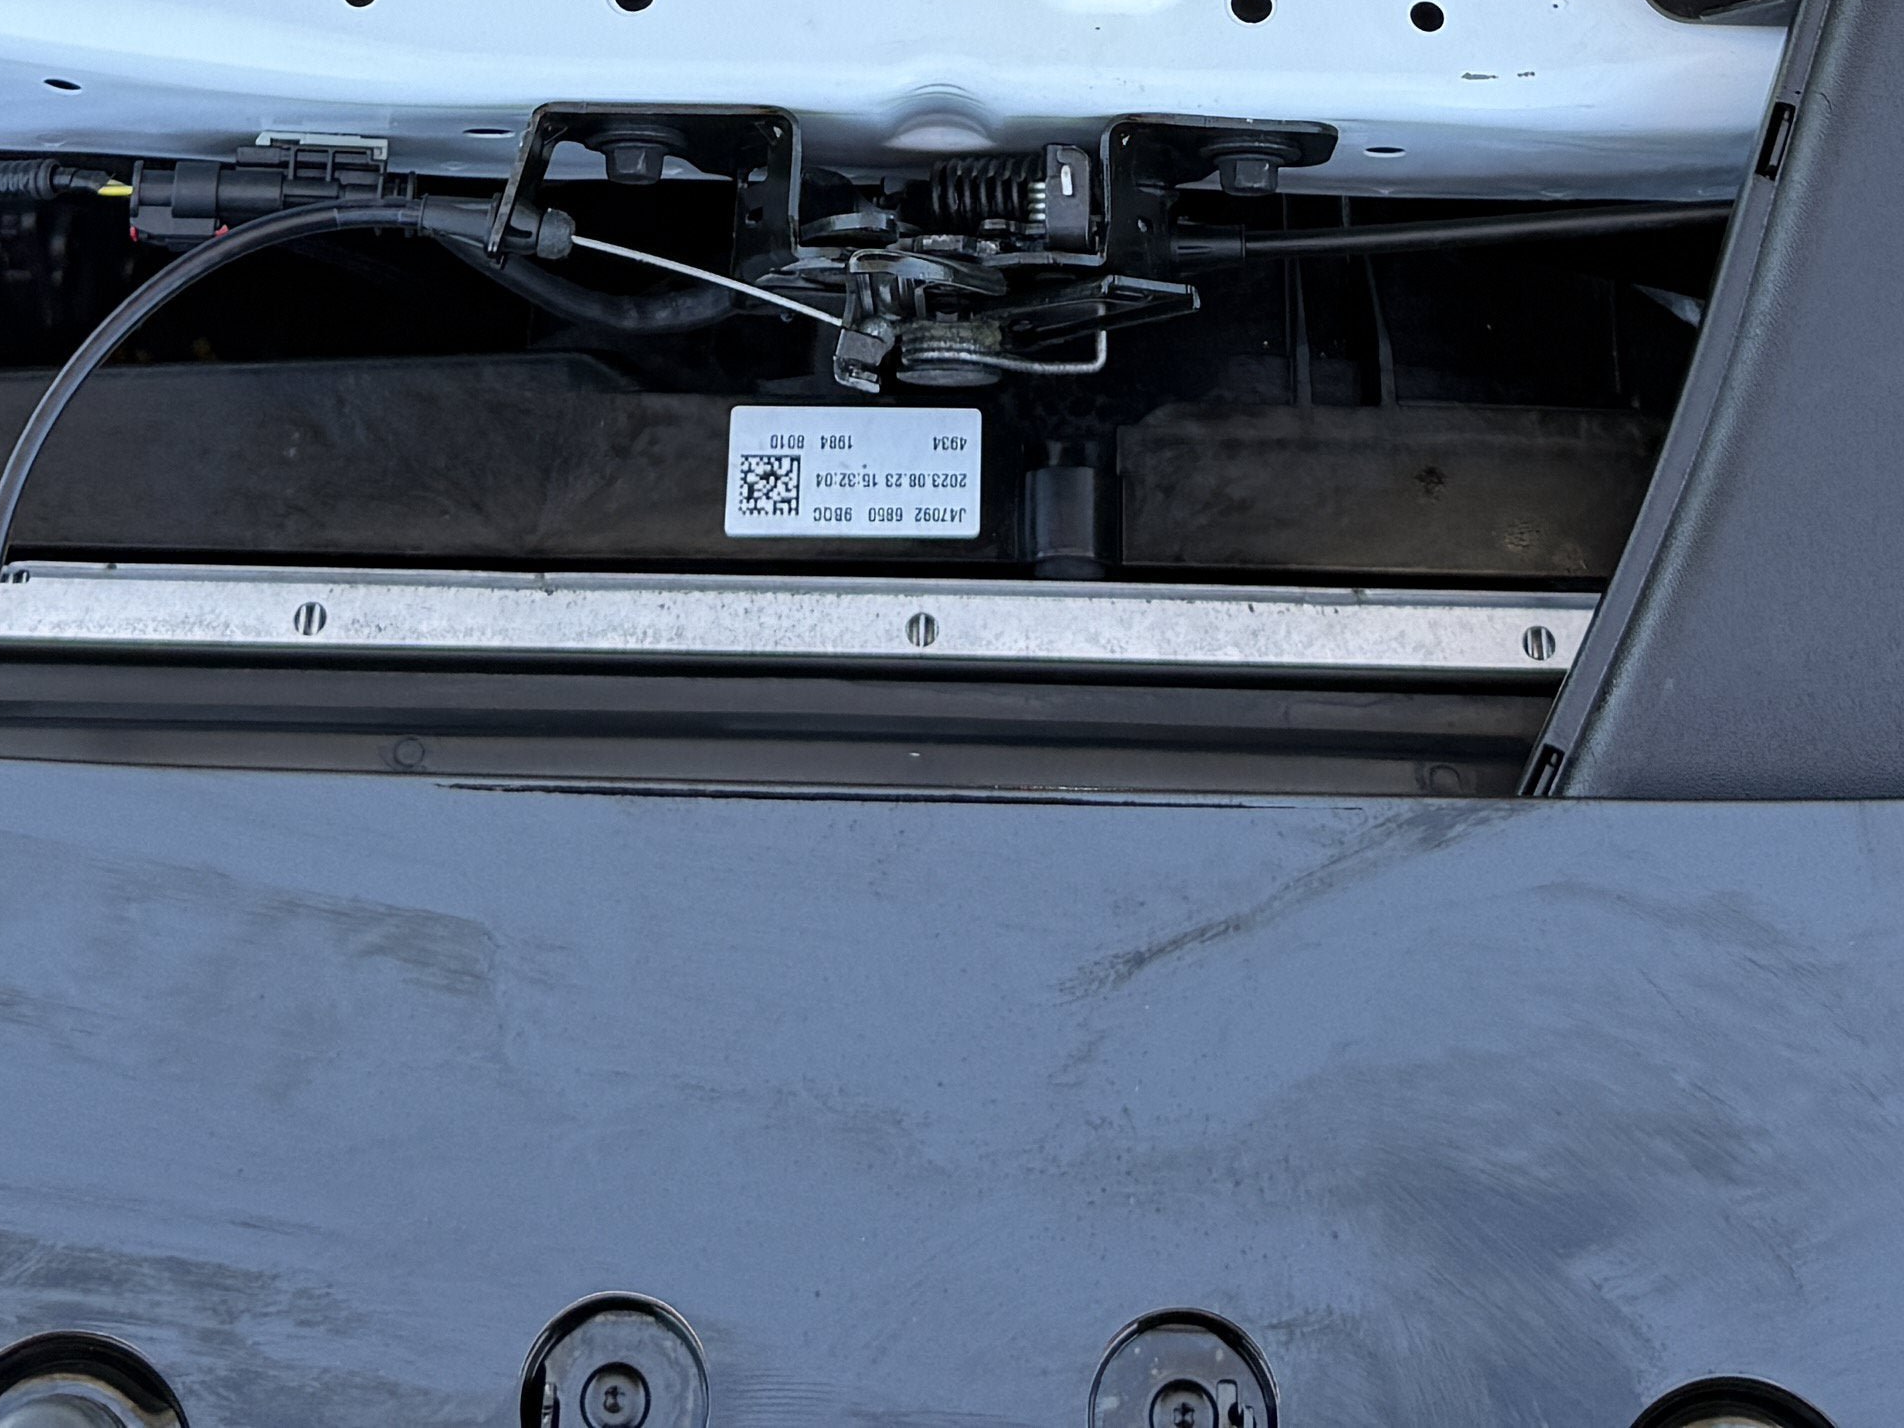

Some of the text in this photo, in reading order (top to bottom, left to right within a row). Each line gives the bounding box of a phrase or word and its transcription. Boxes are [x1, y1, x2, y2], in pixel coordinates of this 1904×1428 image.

[770, 434, 805, 449] 8010
[884, 472, 968, 488] 2023.08.23
[913, 506, 967, 523] J47092
